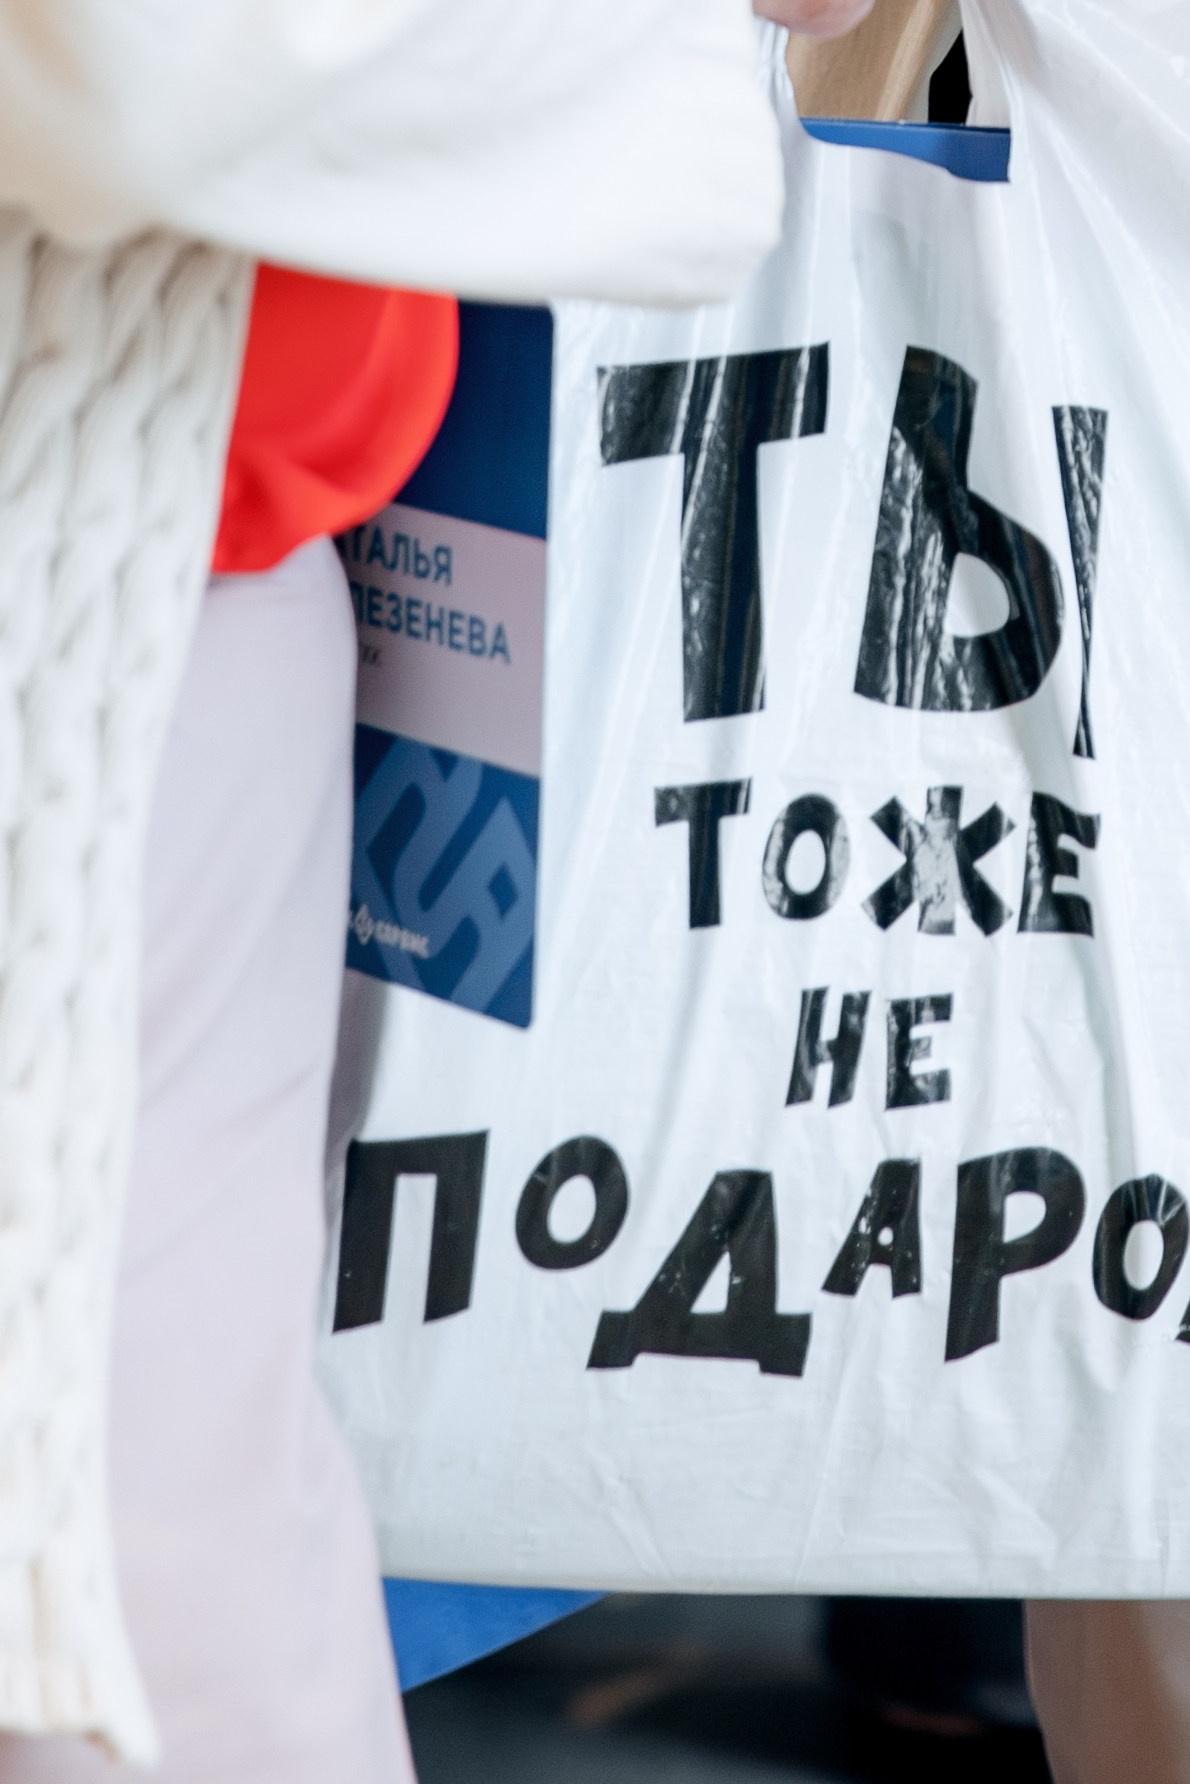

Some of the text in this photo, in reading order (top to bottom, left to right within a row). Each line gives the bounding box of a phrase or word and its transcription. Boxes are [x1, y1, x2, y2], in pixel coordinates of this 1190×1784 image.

[597, 341, 1108, 760] ТЫ
[653, 776, 1101, 937] ТОЖЕ
[785, 986, 954, 1111] НЕ
